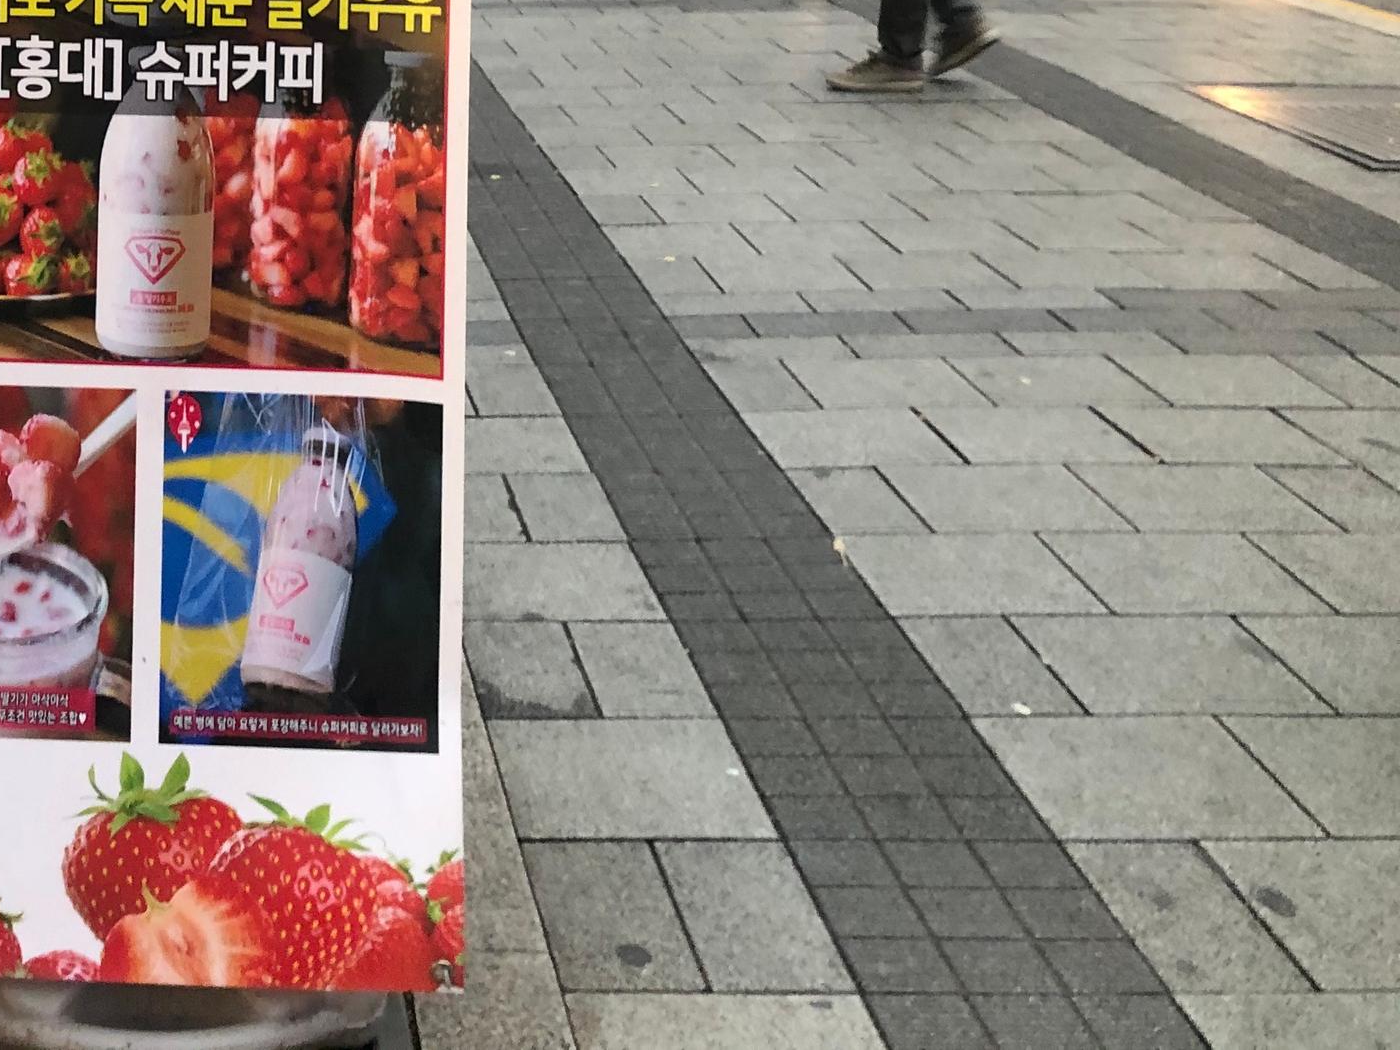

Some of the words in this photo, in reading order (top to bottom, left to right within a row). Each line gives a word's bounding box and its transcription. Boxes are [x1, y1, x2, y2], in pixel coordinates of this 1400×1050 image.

[136, 40, 324, 104] 슈퍼커피
[271, 718, 318, 734] 포장해주니
[321, 720, 367, 736] 슈퍼커피로
